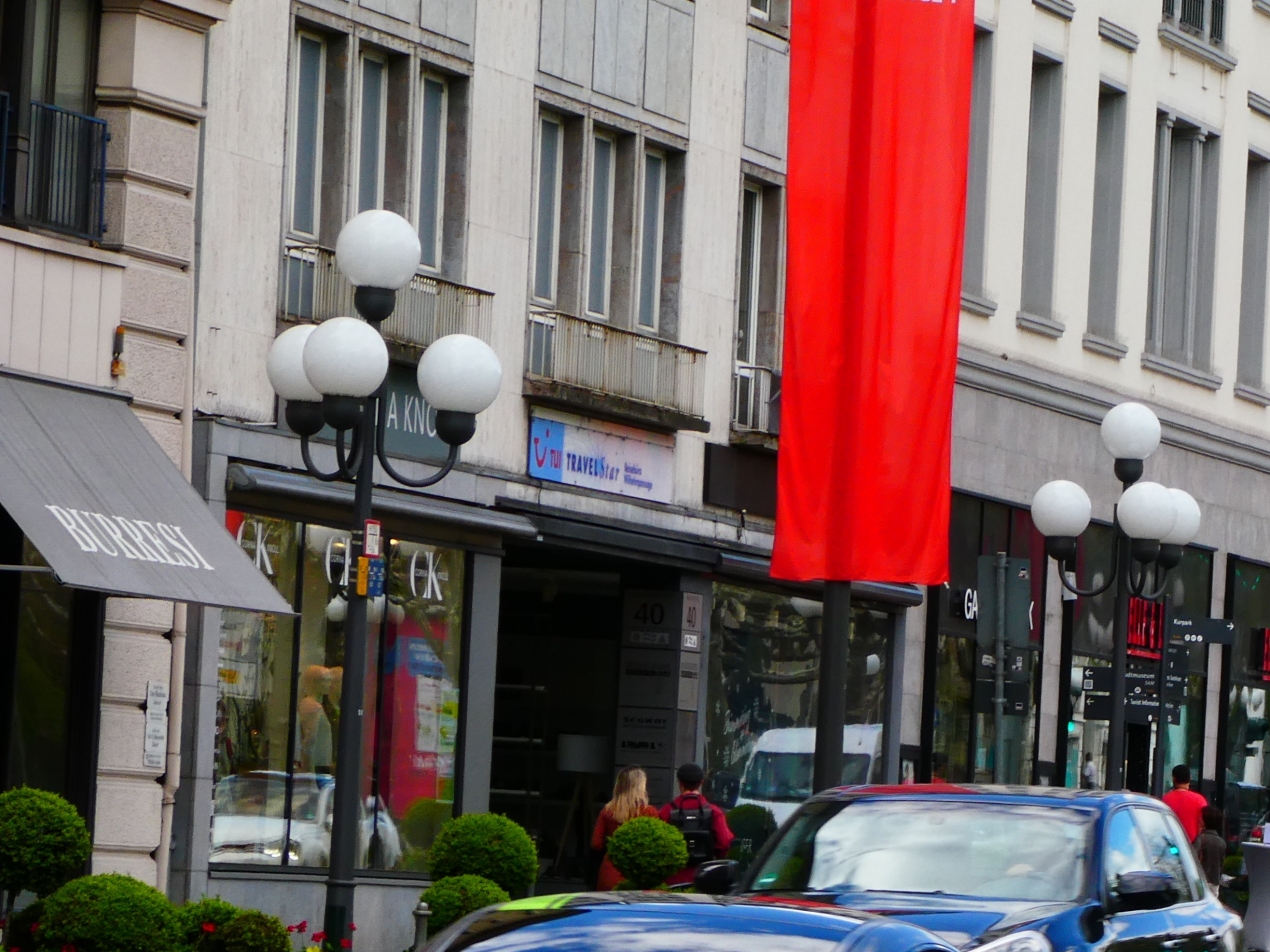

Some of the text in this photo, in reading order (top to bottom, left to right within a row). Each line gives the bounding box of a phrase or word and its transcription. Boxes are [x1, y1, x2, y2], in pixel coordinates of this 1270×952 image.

[550, 448, 562, 469] TUI
[44, 504, 215, 570] BURRESI
[634, 602, 665, 625] 40
[686, 606, 697, 628] 40
